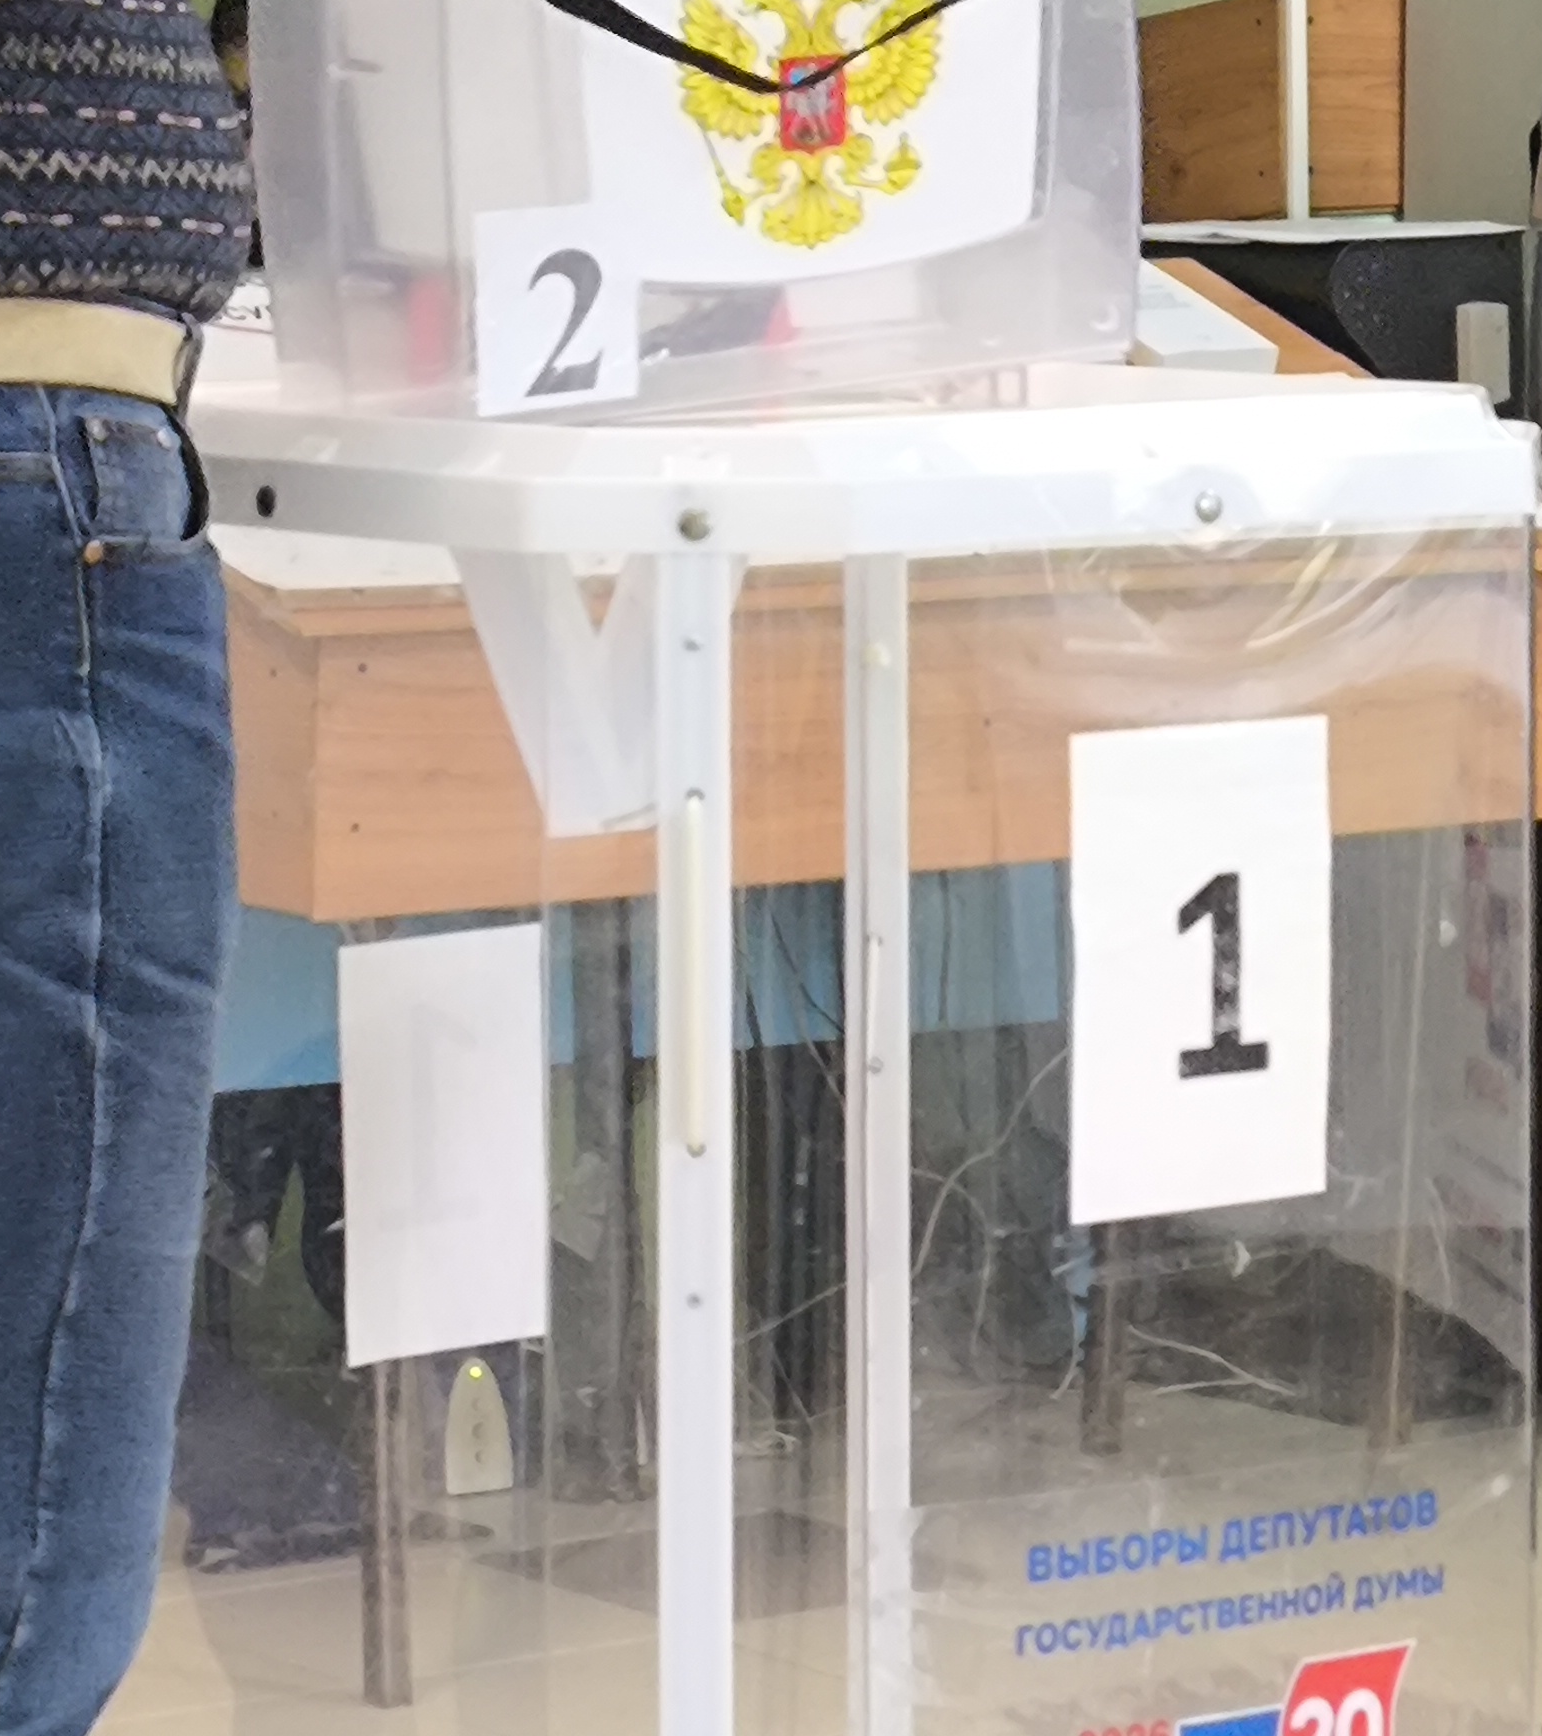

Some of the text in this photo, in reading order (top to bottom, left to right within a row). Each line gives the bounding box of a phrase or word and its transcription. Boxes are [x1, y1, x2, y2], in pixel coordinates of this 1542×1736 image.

[524, 247, 604, 399] 2
[1177, 870, 1270, 1080] 1
[1027, 1488, 1439, 1585] ВЫБОРЫ ДЕПУТАТОВ
[1014, 1564, 1446, 1657] ГОСУДАРСТВЕННОЙ ДУМЫ
